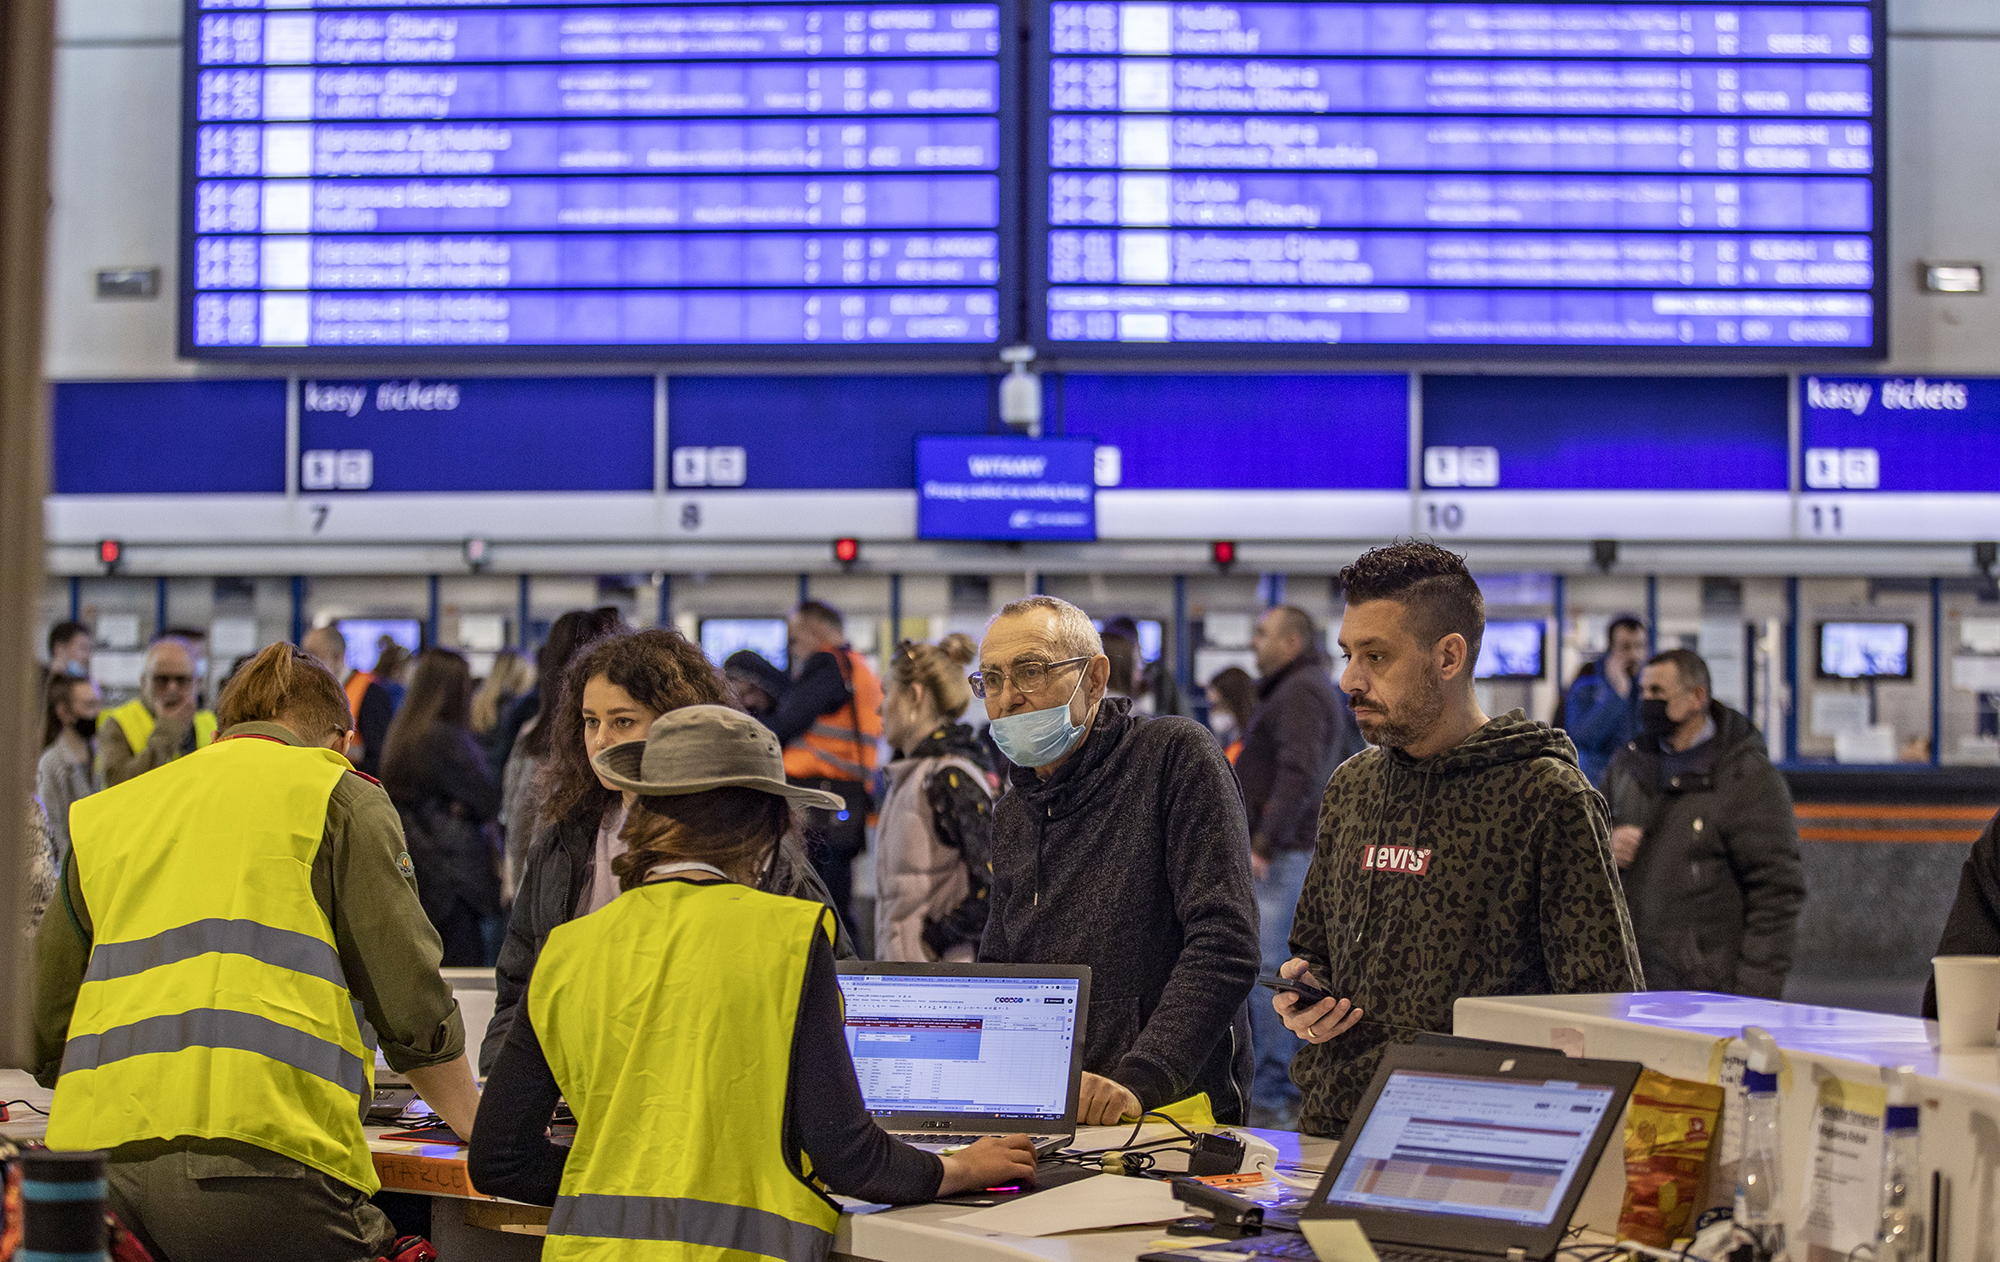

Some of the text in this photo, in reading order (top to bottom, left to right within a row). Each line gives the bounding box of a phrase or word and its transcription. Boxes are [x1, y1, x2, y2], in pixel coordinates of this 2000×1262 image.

[305, 379, 460, 417] kasy tickets
[1808, 376, 1968, 415] kasy tickets
[311, 504, 329, 533] 7
[681, 503, 701, 531] 8
[1427, 503, 1464, 531] 10
[1811, 505, 1842, 533] 11
